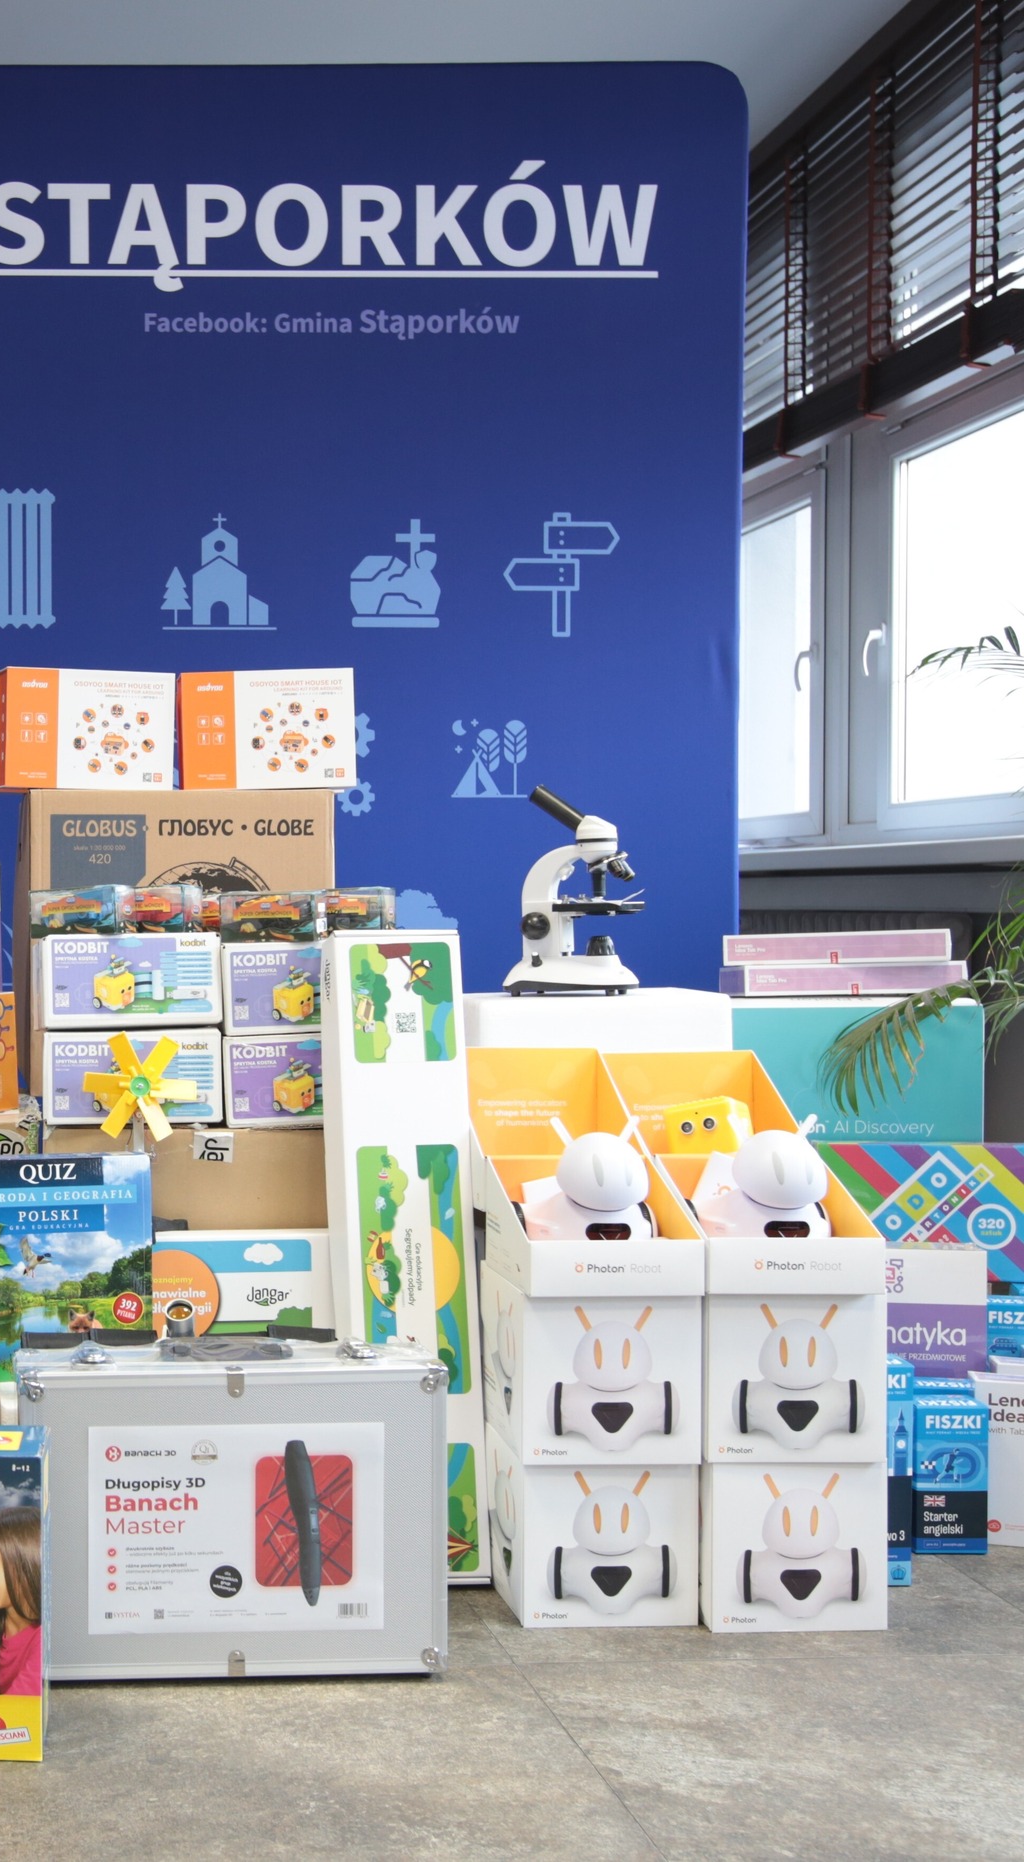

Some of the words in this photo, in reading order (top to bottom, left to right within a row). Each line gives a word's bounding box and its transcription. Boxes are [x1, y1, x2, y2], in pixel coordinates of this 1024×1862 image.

[144, 312, 268, 333] Facebook:
[274, 311, 353, 333] Gmina
[360, 307, 520, 340] Stąporków
[74, 680, 103, 688] OSOYOO
[104, 681, 127, 689] SMART
[249, 680, 279, 688] OSOYOO
[280, 679, 304, 687] SMART
[62, 819, 137, 837] GLOBUS
[158, 819, 233, 836] ГЛОБУС
[253, 819, 314, 836] GLOBE
[89, 853, 112, 864] 420
[54, 942, 109, 954] KODBIT
[233, 953, 288, 967] KODBIT
[54, 1044, 110, 1057] KODBIT
[181, 1042, 208, 1051] kodbit
[232, 1045, 287, 1060] KODBIT
[478, 1100, 527, 1108] Empowering
[527, 1099, 567, 1107] educators
[494, 1109, 518, 1118] shape
[834, 1120, 849, 1134] AI
[855, 1120, 934, 1137] Discovery
[19, 1163, 77, 1184] QUIZ
[42, 1192, 47, 1201] I
[53, 1189, 133, 1201] GEOGRAFIA
[18, 1209, 79, 1222] POLSKI
[978, 1218, 1005, 1229] 320
[404, 1228, 414, 1278] Segregujemy
[414, 1242, 422, 1254] Gra
[587, 1263, 624, 1273] Photon
[630, 1263, 662, 1273] Robot
[767, 1260, 805, 1271] Photon
[810, 1261, 842, 1271] Robot
[415, 1254, 424, 1291] edukacyjna
[247, 1286, 290, 1304] Jangar
[406, 1278, 415, 1306] odpady
[119, 1298, 137, 1311] 392
[908, 1353, 967, 1362] PRZEDMIOTOWE
[926, 1415, 982, 1429] FISZKI
[988, 1427, 1007, 1435] with
[542, 1448, 567, 1456] Photon
[728, 1446, 753, 1454] Photon
[105, 1477, 182, 1492] Długopisy
[185, 1477, 206, 1488] 3D
[105, 1492, 198, 1512] Banach
[923, 1511, 958, 1522] Starter
[106, 1517, 186, 1535] Master
[923, 1524, 963, 1537] angielski
[899, 1530, 905, 1541] 3
[542, 1612, 568, 1620] Photon
[731, 1616, 757, 1624] Photon
